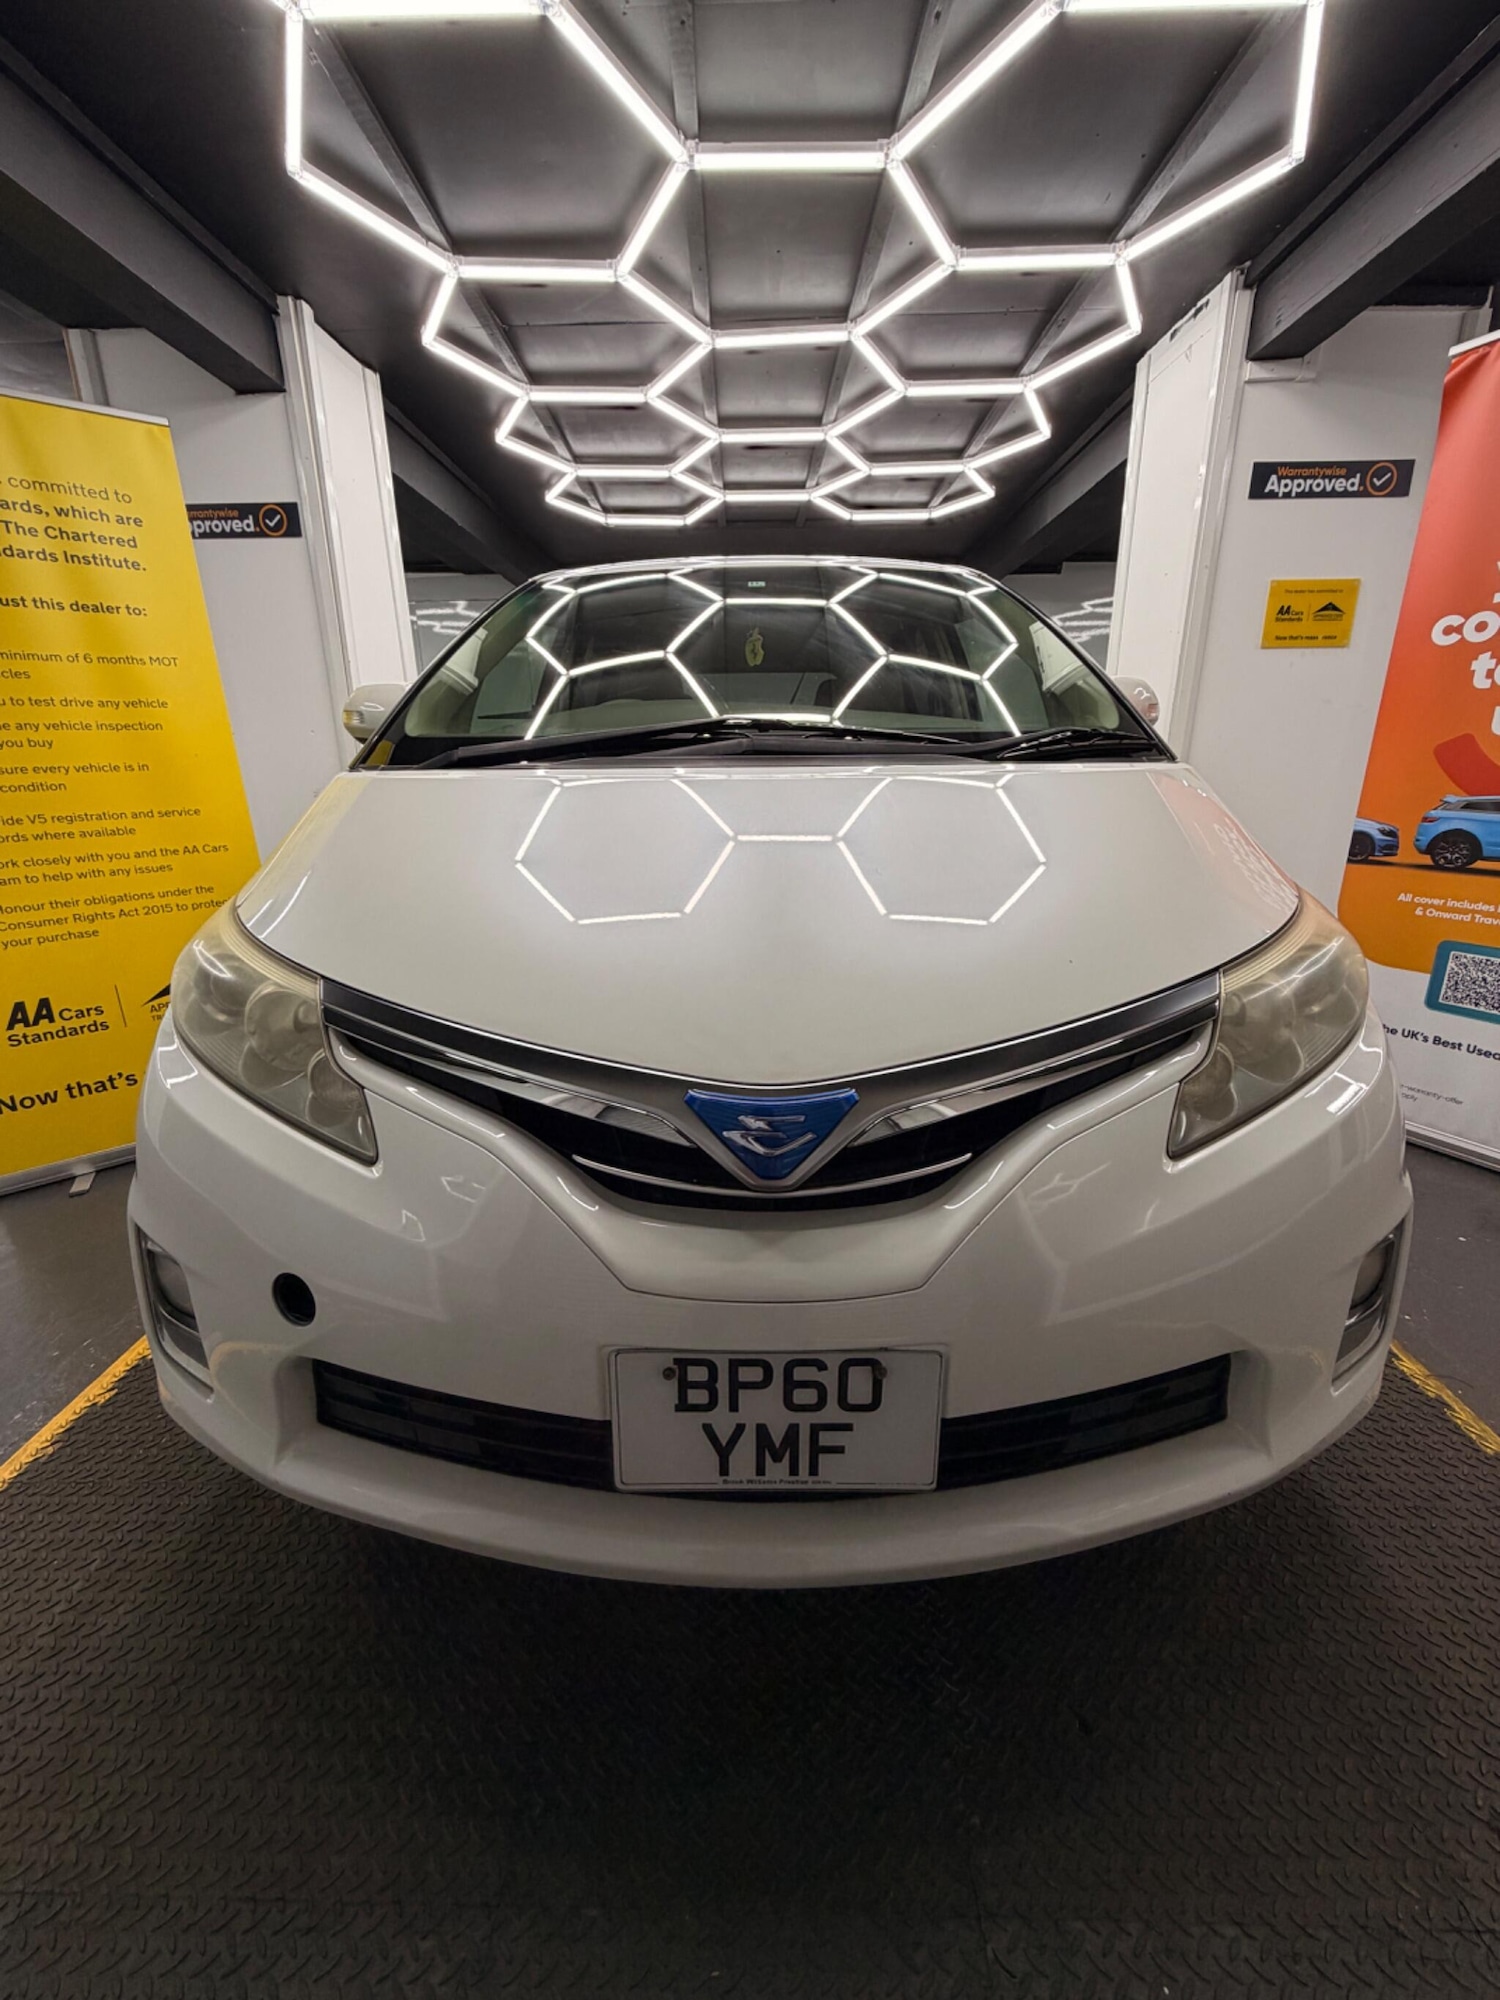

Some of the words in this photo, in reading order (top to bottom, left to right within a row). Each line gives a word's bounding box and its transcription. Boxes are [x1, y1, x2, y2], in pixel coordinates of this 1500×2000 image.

[1277, 465, 1348, 478] Warrantywise
[8, 476, 109, 501] committed
[114, 489, 132, 504] to
[1264, 473, 1364, 498] Approved.
[53, 505, 111, 523] which
[115, 514, 144, 527] are
[187, 508, 239, 519] rrantywise
[0, 520, 39, 538] The
[44, 525, 138, 549] Chartered
[0, 544, 59, 563] dards
[63, 550, 147, 571] Institute.
[32, 597, 65, 611] this
[69, 600, 122, 614] dealer
[125, 604, 148, 617] to:
[66, 653, 80, 664] of
[83, 653, 93, 664] 6
[97, 655, 146, 666] months
[149, 656, 179, 667] MOT
[9, 696, 25, 706] to
[28, 696, 57, 707] test
[59, 696, 94, 708] drive
[97, 700, 120, 710] any
[123, 698, 169, 709] vehicle
[15, 722, 39, 733] any
[43, 720, 93, 731] vehicle
[96, 720, 163, 733] inspection
[27, 738, 54, 750] buy
[32, 764, 70, 776] every
[73, 762, 121, 773] vehicle
[124, 762, 135, 772] is
[138, 762, 149, 772] in
[0, 781, 67, 793] condition
[26, 815, 47, 825] V5
[51, 810, 128, 826] registration
[131, 809, 154, 820] and
[157, 806, 201, 818] service
[31, 830, 75, 841] where
[79, 826, 136, 838] available
[23, 853, 71, 869] closely
[74, 851, 104, 863] with
[107, 852, 130, 863] you
[133, 848, 157, 859] and
[159, 846, 180, 857] the
[182, 844, 200, 855] AA
[202, 842, 229, 853] Cars
[24, 874, 40, 884] to
[43, 871, 73, 884] help
[76, 869, 106, 880] with
[109, 866, 131, 878] any
[134, 863, 173, 874] issues
[49, 898, 81, 910] their
[83, 891, 155, 906] obligations
[157, 887, 193, 898] under
[195, 884, 215, 895] the
[1397, 892, 1413, 902] All
[1414, 896, 1445, 906] cover
[1446, 898, 1495, 912] includes
[0, 917, 69, 932] Consumer
[72, 910, 115, 925] Rights
[118, 907, 140, 918] Act
[142, 904, 173, 916] 2015
[176, 901, 189, 911] to
[1415, 907, 1424, 916] &
[1426, 908, 1472, 922] Onward
[1474, 914, 1500, 925] Trav
[1, 938, 33, 950] your
[37, 928, 100, 945] purchase
[6, 997, 56, 1031] AA
[58, 1004, 105, 1021] Cars
[7, 1020, 110, 1048] Standards
[1401, 1028, 1429, 1043] UK's
[1432, 1035, 1463, 1051] Best
[0, 1090, 58, 1115] Now
[64, 1072, 138, 1099] that's
[672, 1357, 883, 1413] BP60
[702, 1423, 854, 1477] YMF
